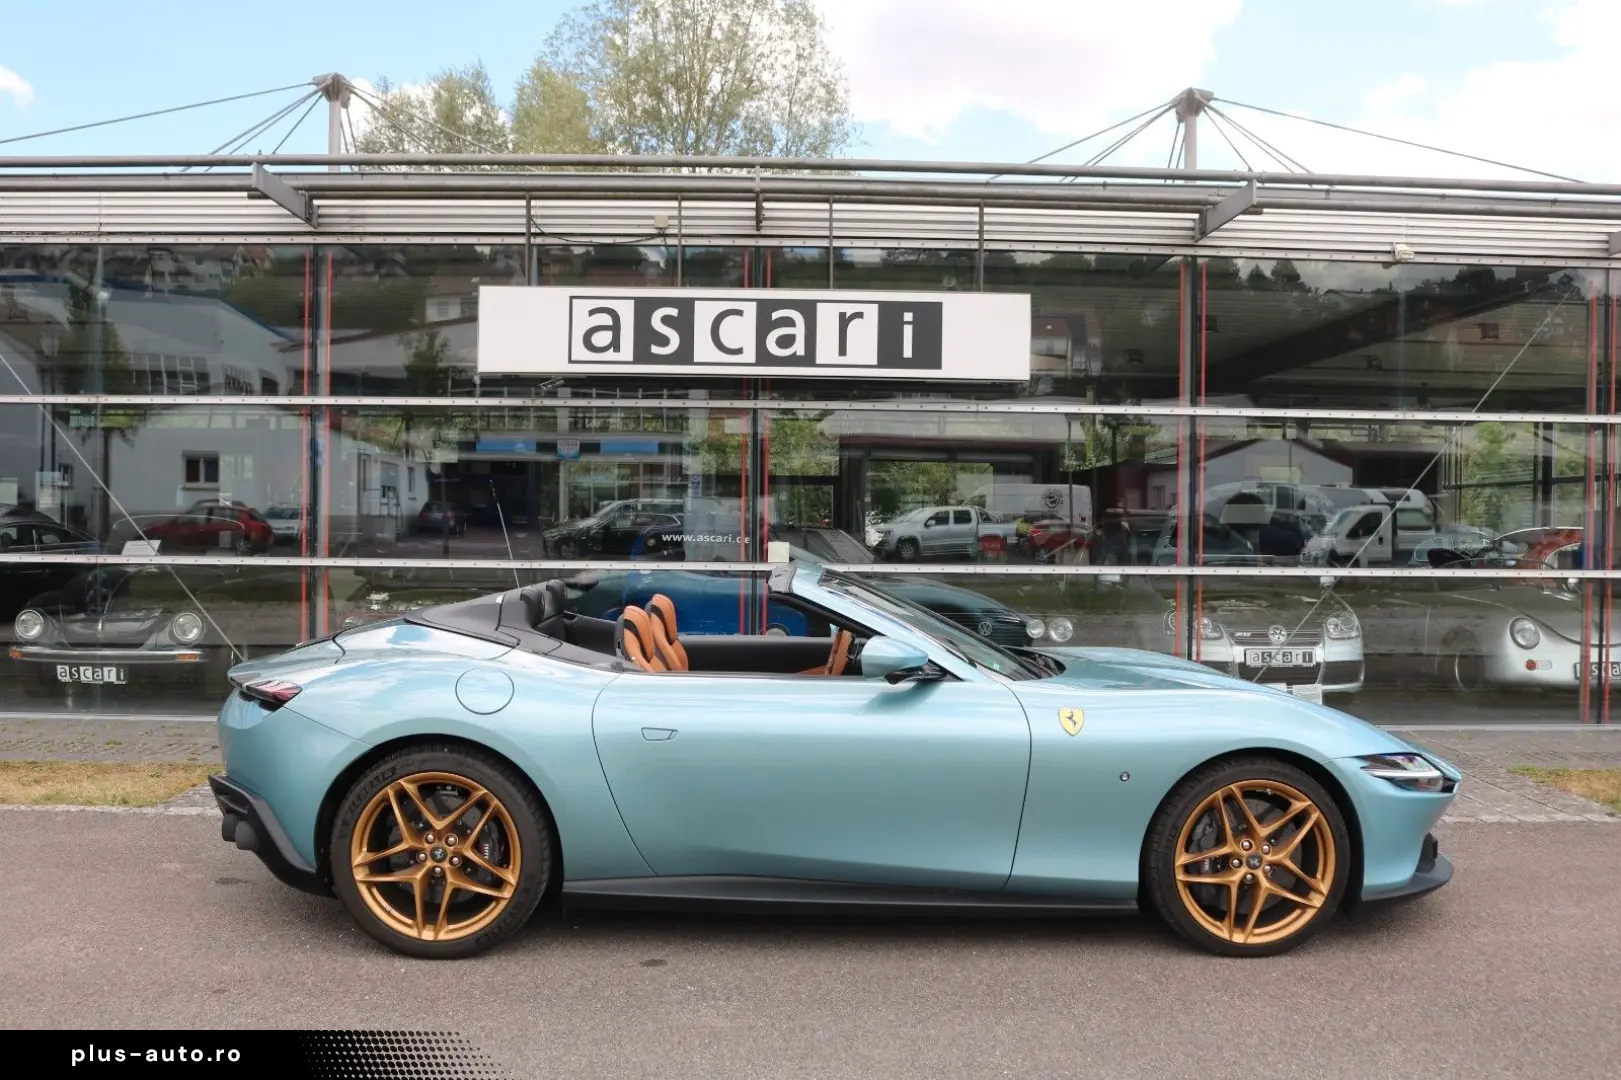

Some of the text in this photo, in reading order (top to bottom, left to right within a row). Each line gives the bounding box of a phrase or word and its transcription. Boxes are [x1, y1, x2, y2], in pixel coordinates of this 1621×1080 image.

[581, 304, 914, 359] ascari
[1251, 650, 1311, 663] ascari
[58, 666, 126, 681] ascari
